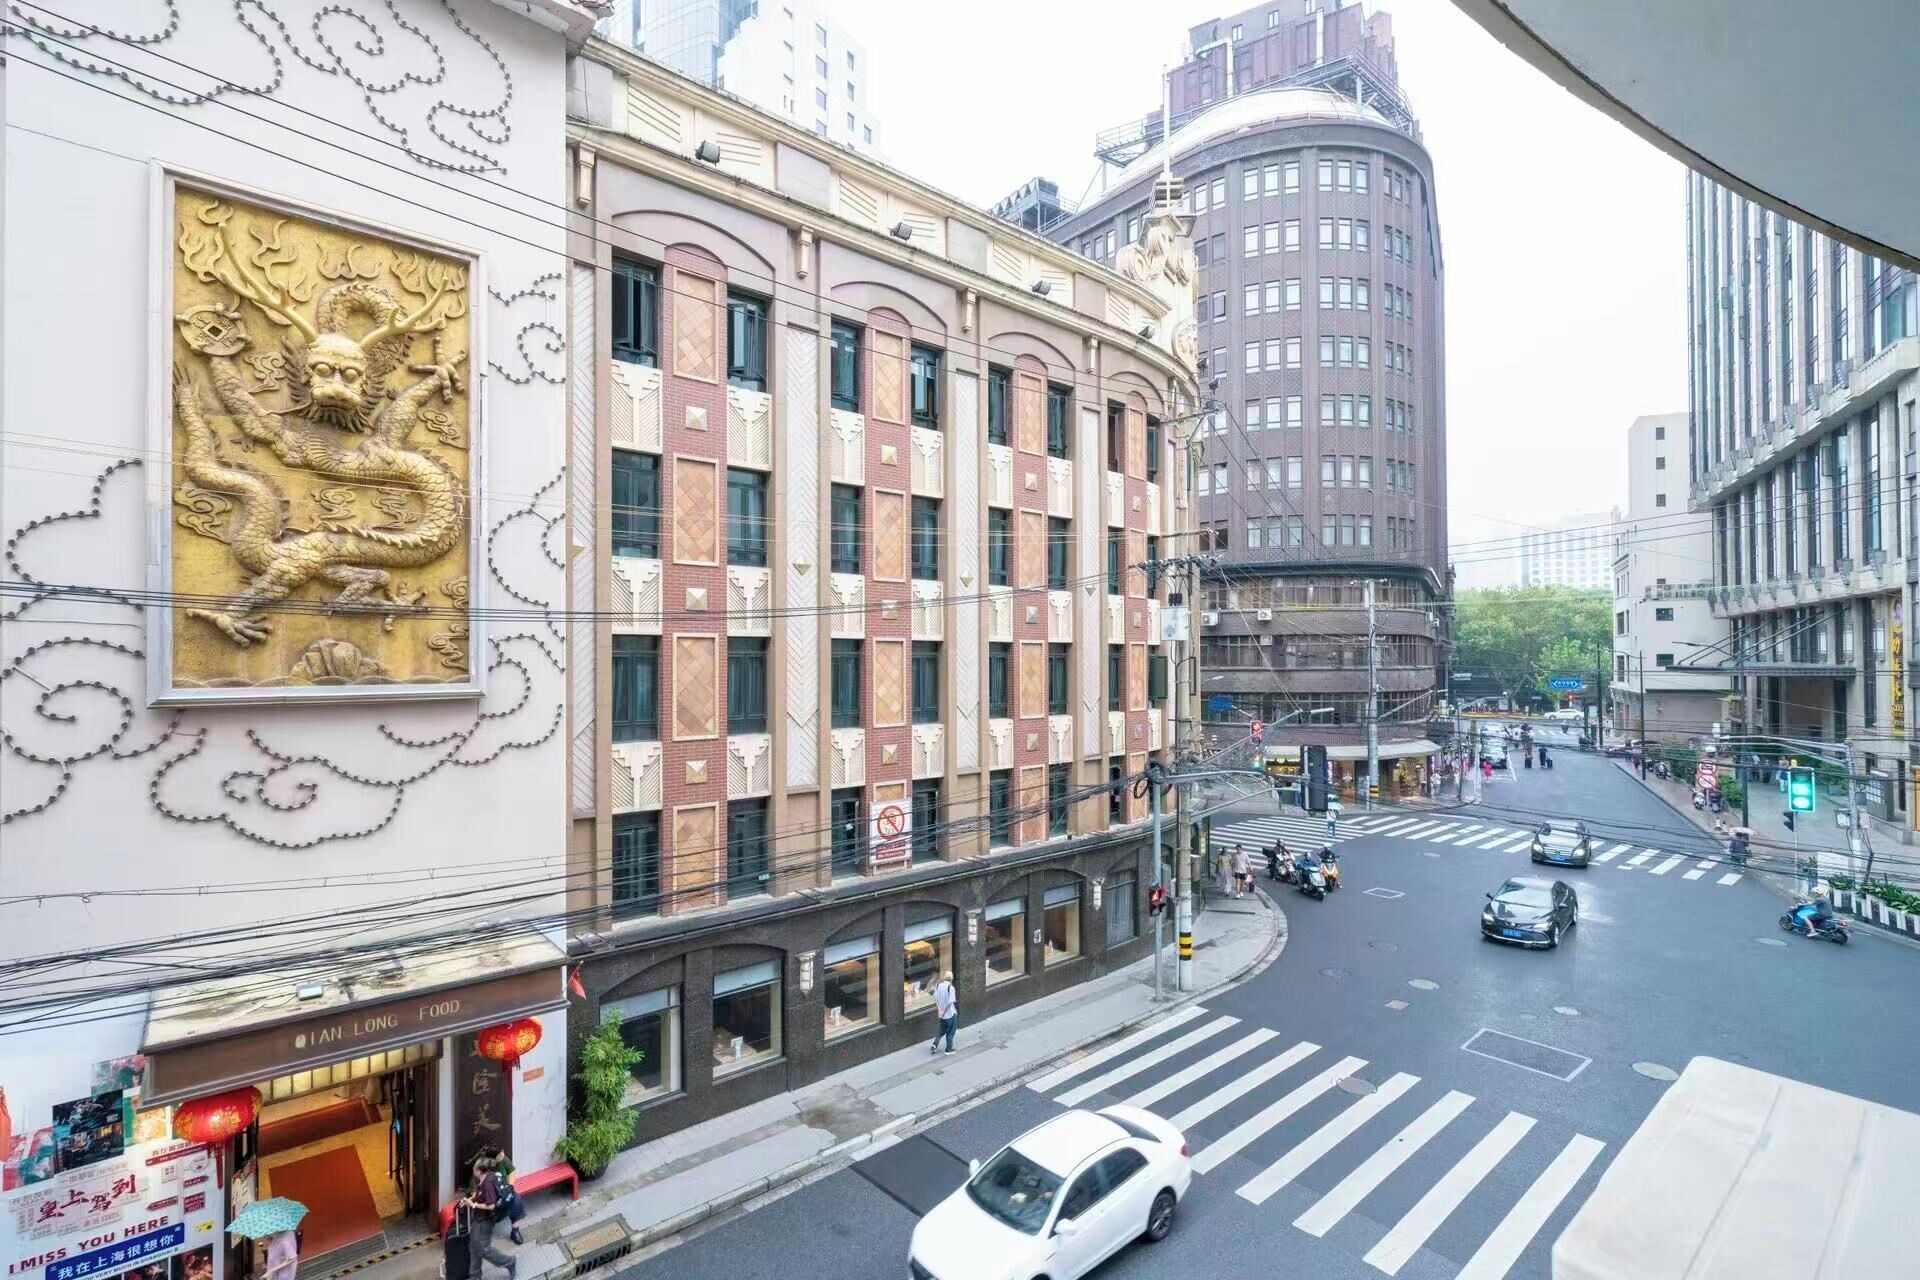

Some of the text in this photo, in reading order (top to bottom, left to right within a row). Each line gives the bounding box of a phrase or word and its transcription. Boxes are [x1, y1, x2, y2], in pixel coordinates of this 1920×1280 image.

[354, 1014, 398, 1036] LONG
[419, 1000, 460, 1021] FOOD
[37, 1174, 136, 1223] 皇上驾到
[9, 1264, 14, 1274] I
[20, 1248, 66, 1270] MISS
[78, 1232, 115, 1250] YOU
[124, 1216, 168, 1237] HERE
[57, 1233, 174, 1280] 我在上海很想你
[95, 1270, 112, 1279] VERY
[113, 1263, 131, 1273] MUCH
[140, 1249, 172, 1264] SHANGHAI
